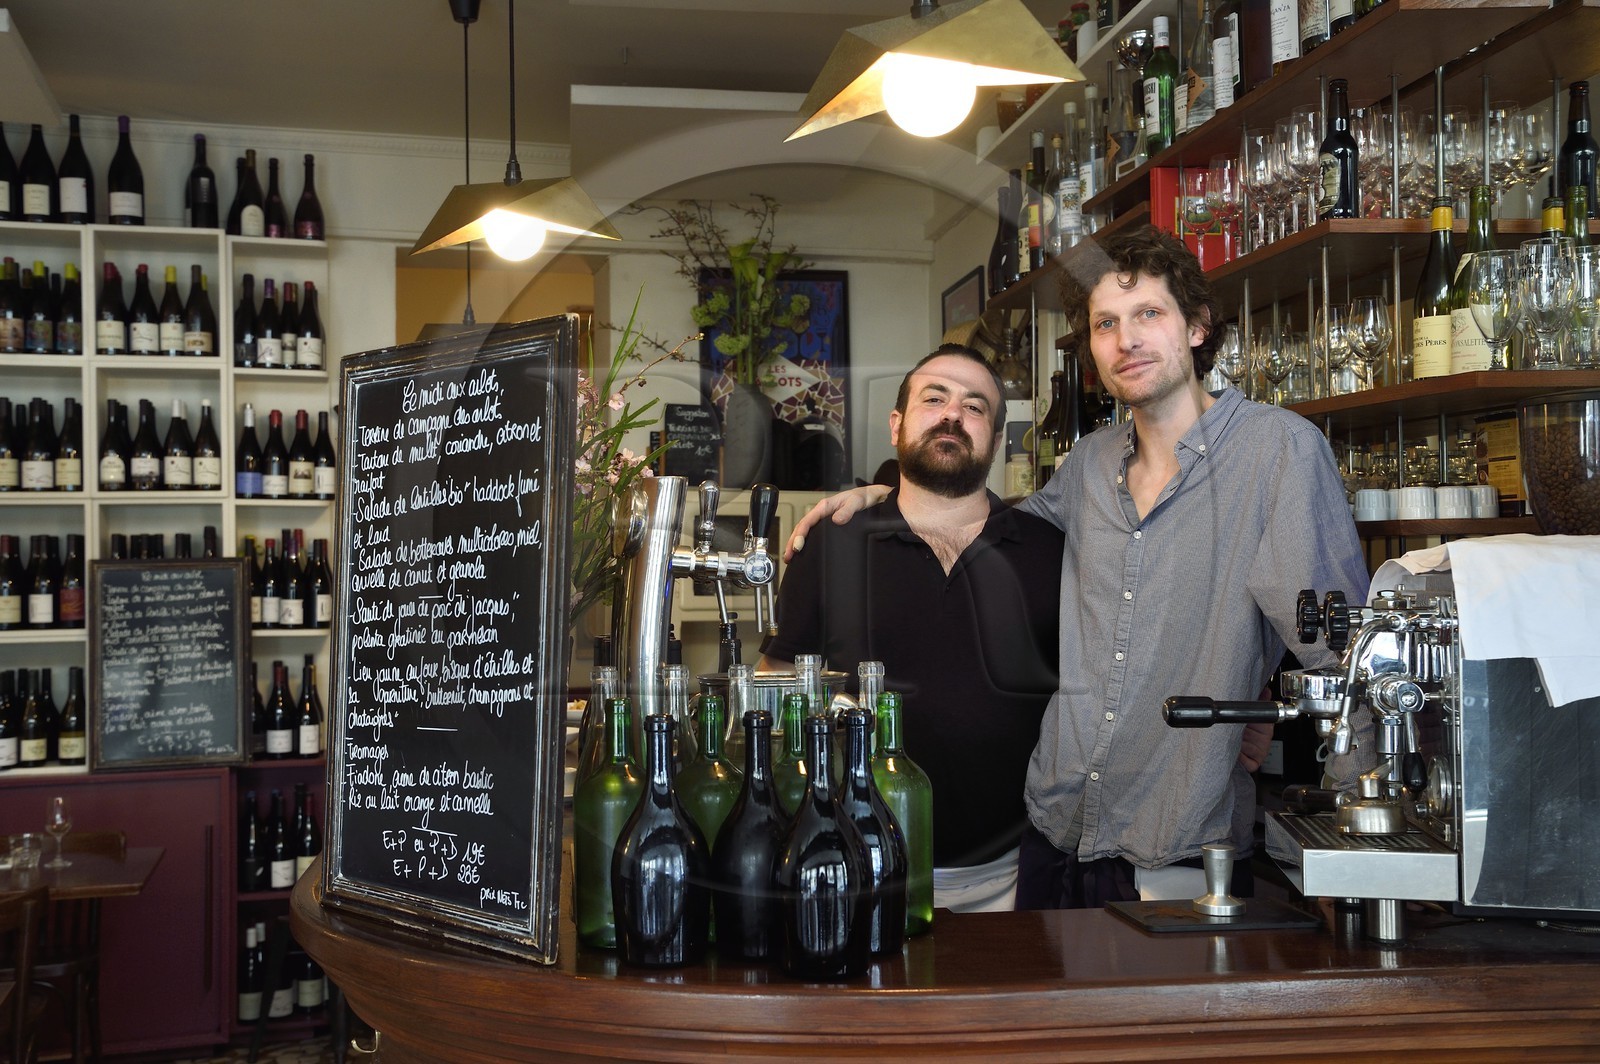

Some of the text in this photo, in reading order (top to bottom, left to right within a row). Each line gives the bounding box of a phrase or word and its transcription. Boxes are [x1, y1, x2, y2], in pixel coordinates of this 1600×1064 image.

[768, 365, 787, 374] LES
[418, 381, 444, 410] midi
[446, 381, 465, 399] aux
[359, 426, 389, 447] Terrine
[393, 419, 404, 440] de
[407, 413, 452, 446] campagne
[453, 406, 470, 426] des
[392, 446, 404, 465] de
[529, 416, 542, 442] et
[355, 497, 392, 522] Salade
[394, 494, 407, 515] de
[473, 475, 514, 502] haddock
[515, 469, 540, 517] fumé
[354, 529, 363, 549] et
[359, 549, 393, 571] Salade
[396, 541, 407, 563] de
[388, 569, 402, 590] de
[404, 563, 432, 587] canut
[437, 560, 447, 583] et
[448, 555, 486, 602] granola
[382, 600, 394, 621] de
[417, 600, 429, 618] de
[432, 599, 452, 631] porc
[352, 627, 386, 661] polenta
[431, 629, 444, 644] au
[406, 664, 417, 681] au
[521, 653, 534, 674] et
[469, 683, 521, 718] champignons
[524, 682, 534, 700] et
[419, 766, 432, 786] de
[365, 796, 377, 809] au
[380, 788, 400, 810] lait
[404, 796, 435, 829] orange
[440, 791, 452, 812] et
[414, 838, 425, 852] ou
